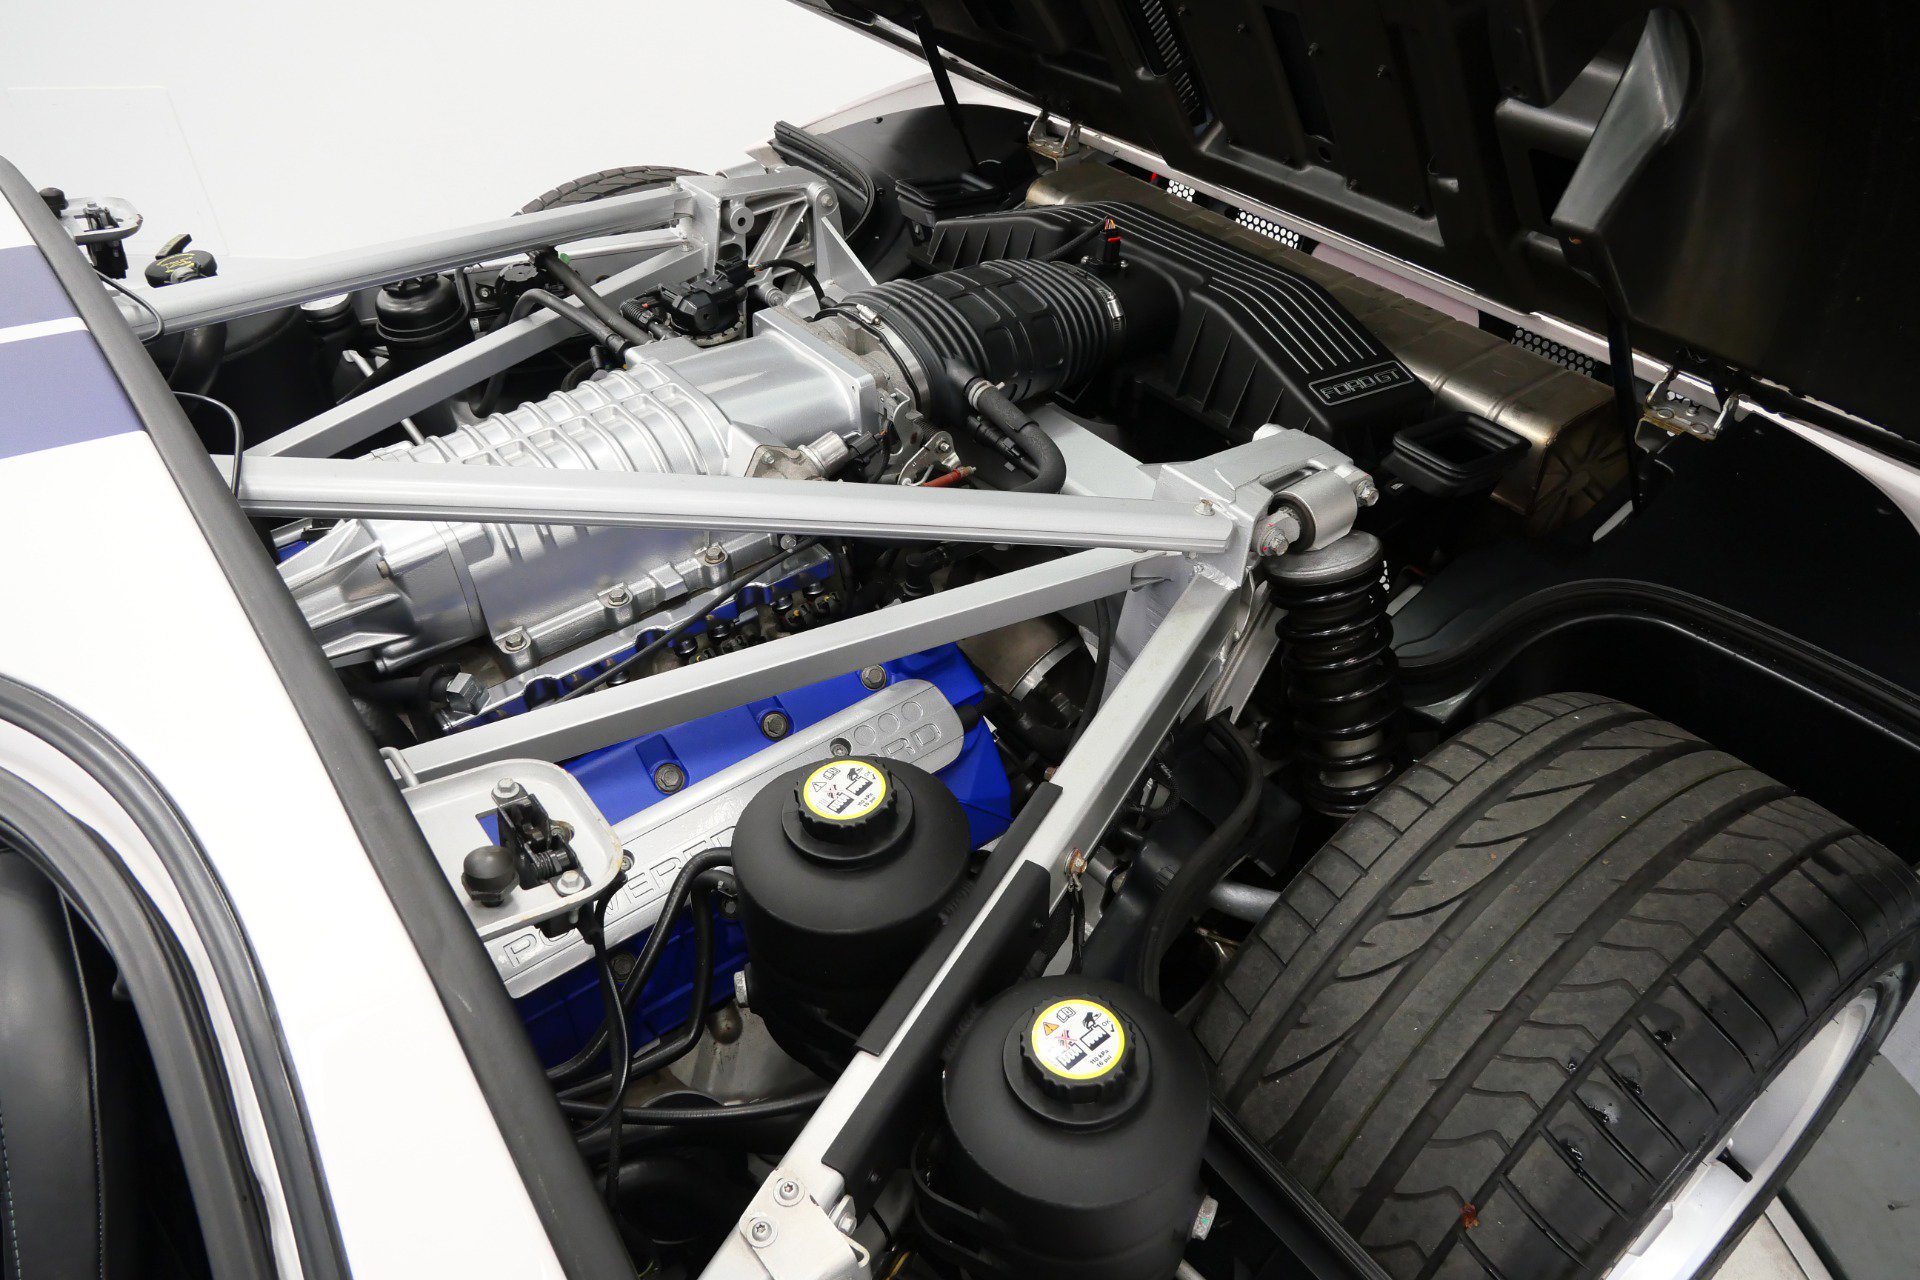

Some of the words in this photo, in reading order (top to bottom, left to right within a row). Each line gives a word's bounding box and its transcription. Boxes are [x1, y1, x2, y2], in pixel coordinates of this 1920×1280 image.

[1320, 375, 1376, 399] FORD
[1373, 368, 1400, 383] GT
[1101, 1018, 1111, 1026] OK
[1098, 1049, 1109, 1058] kPa
